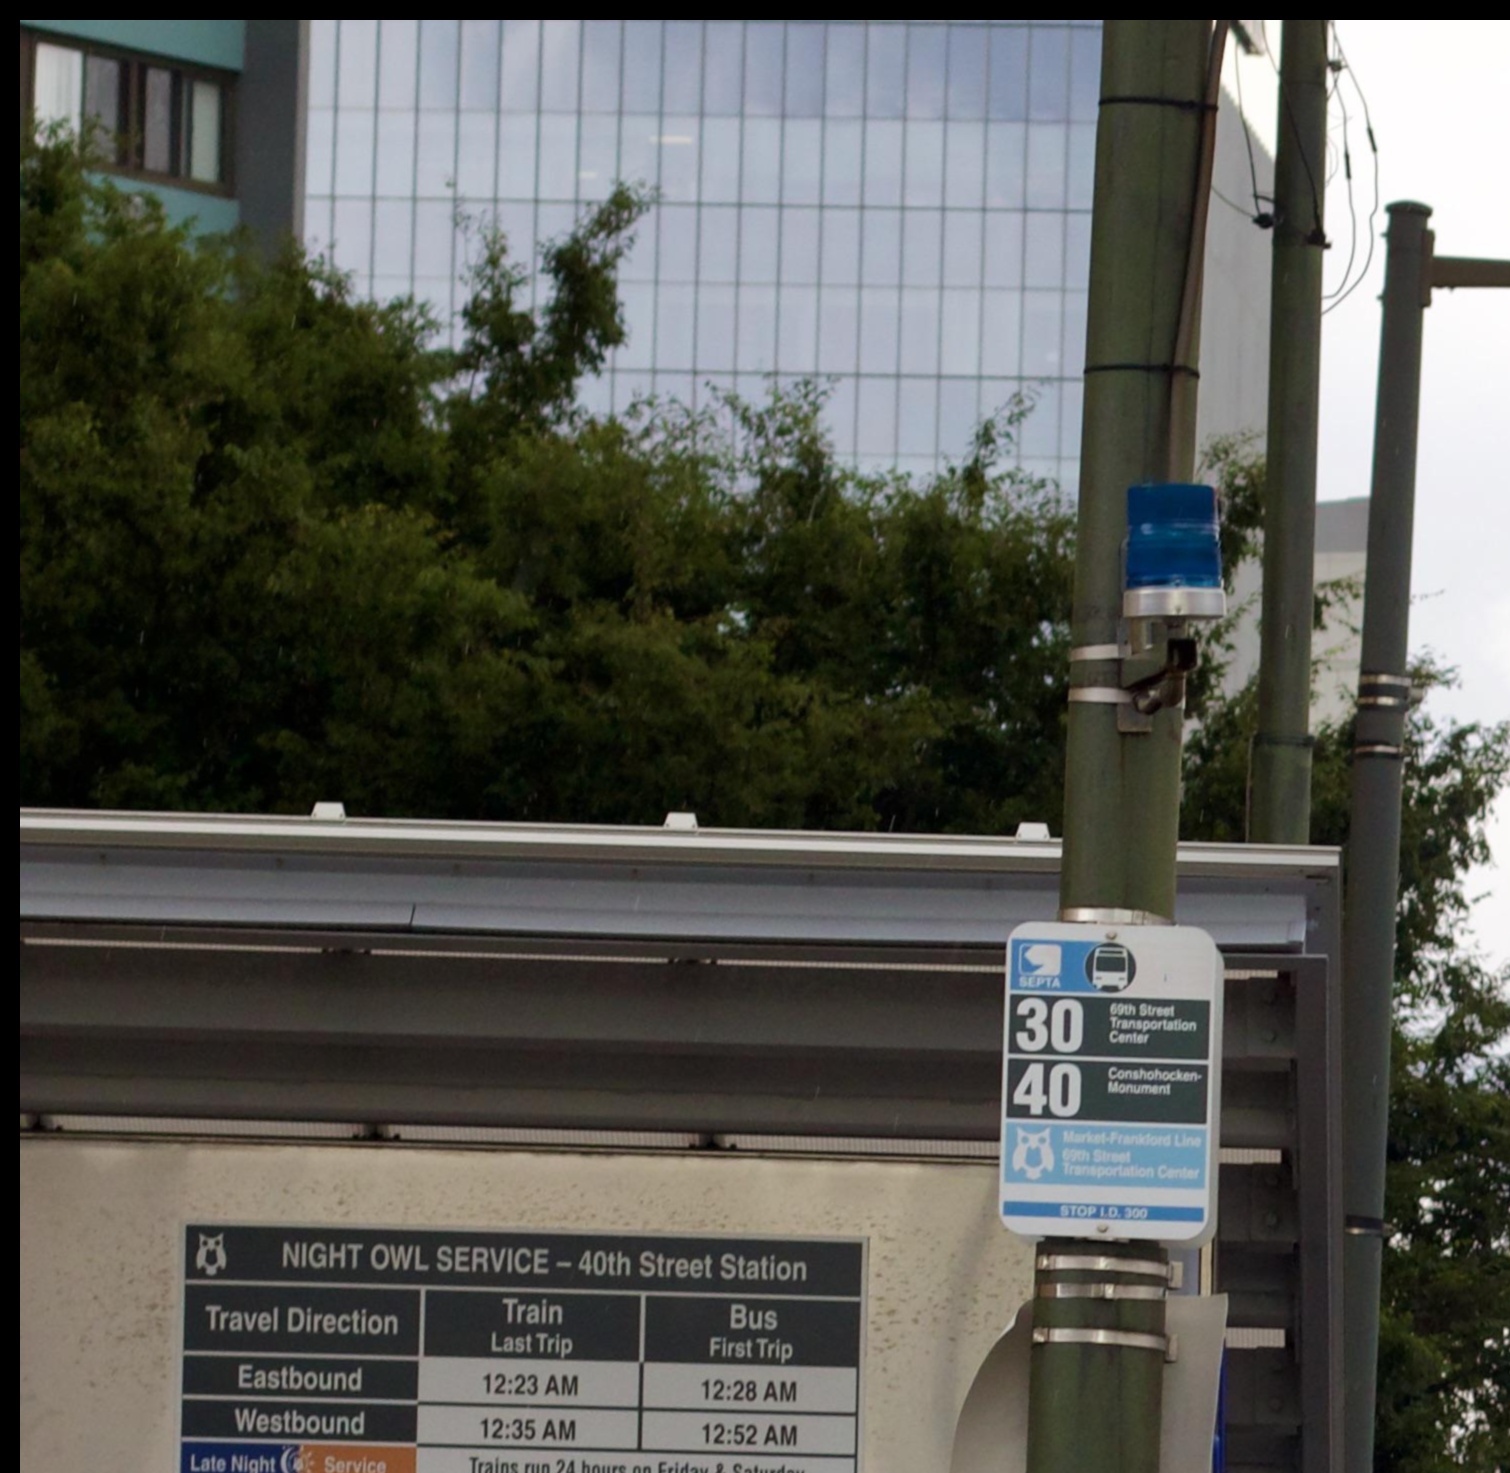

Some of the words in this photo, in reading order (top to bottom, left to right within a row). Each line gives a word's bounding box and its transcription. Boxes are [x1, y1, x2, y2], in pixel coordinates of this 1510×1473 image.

[1018, 976, 1061, 989] SEPTA
[1110, 1003, 1136, 1017] 69th
[1139, 1003, 1175, 1018] Street
[1016, 998, 1085, 1054] 30
[1110, 1017, 1197, 1032] Transportation
[1109, 1031, 1149, 1044] Center
[1108, 1066, 1202, 1082] Conshohocken-
[1013, 1063, 1082, 1117] 40
[1108, 1082, 1171, 1096] Monument
[1062, 1131, 1172, 1147] Market-Frankford
[1174, 1134, 1201, 1149] Line
[1062, 1148, 1090, 1163] 69th
[1093, 1149, 1130, 1163] Street
[1062, 1162, 1155, 1180] Transportation
[1158, 1165, 1200, 1180] Center
[1060, 1205, 1096, 1218] STOP
[1100, 1206, 1122, 1219] I.D.
[1125, 1207, 1148, 1220] 300
[282, 1242, 363, 1270] NIGHT
[370, 1245, 429, 1272] OWL
[436, 1246, 549, 1275] SERVICE
[578, 1250, 631, 1277] 40th
[639, 1253, 712, 1280] Street
[720, 1255, 807, 1281] Station
[205, 1305, 279, 1333] Travel
[287, 1307, 398, 1335] Direction
[502, 1298, 563, 1325] Train
[729, 1304, 778, 1330] Bus
[491, 1332, 532, 1353] Last
[535, 1334, 573, 1358] Trip
[709, 1337, 755, 1359] First
[756, 1339, 794, 1363] Trip
[238, 1364, 363, 1391] Eastbound
[483, 1373, 538, 1396] 12:23
[544, 1375, 579, 1397] AM
[702, 1380, 757, 1402] 12:28
[763, 1382, 797, 1402] AM
[235, 1408, 365, 1435] Westbound
[481, 1418, 536, 1440] 12:35
[542, 1420, 576, 1441] AM
[702, 1424, 758, 1445] 12:52
[764, 1425, 798, 1446] AM
[190, 1454, 226, 1472] Late
